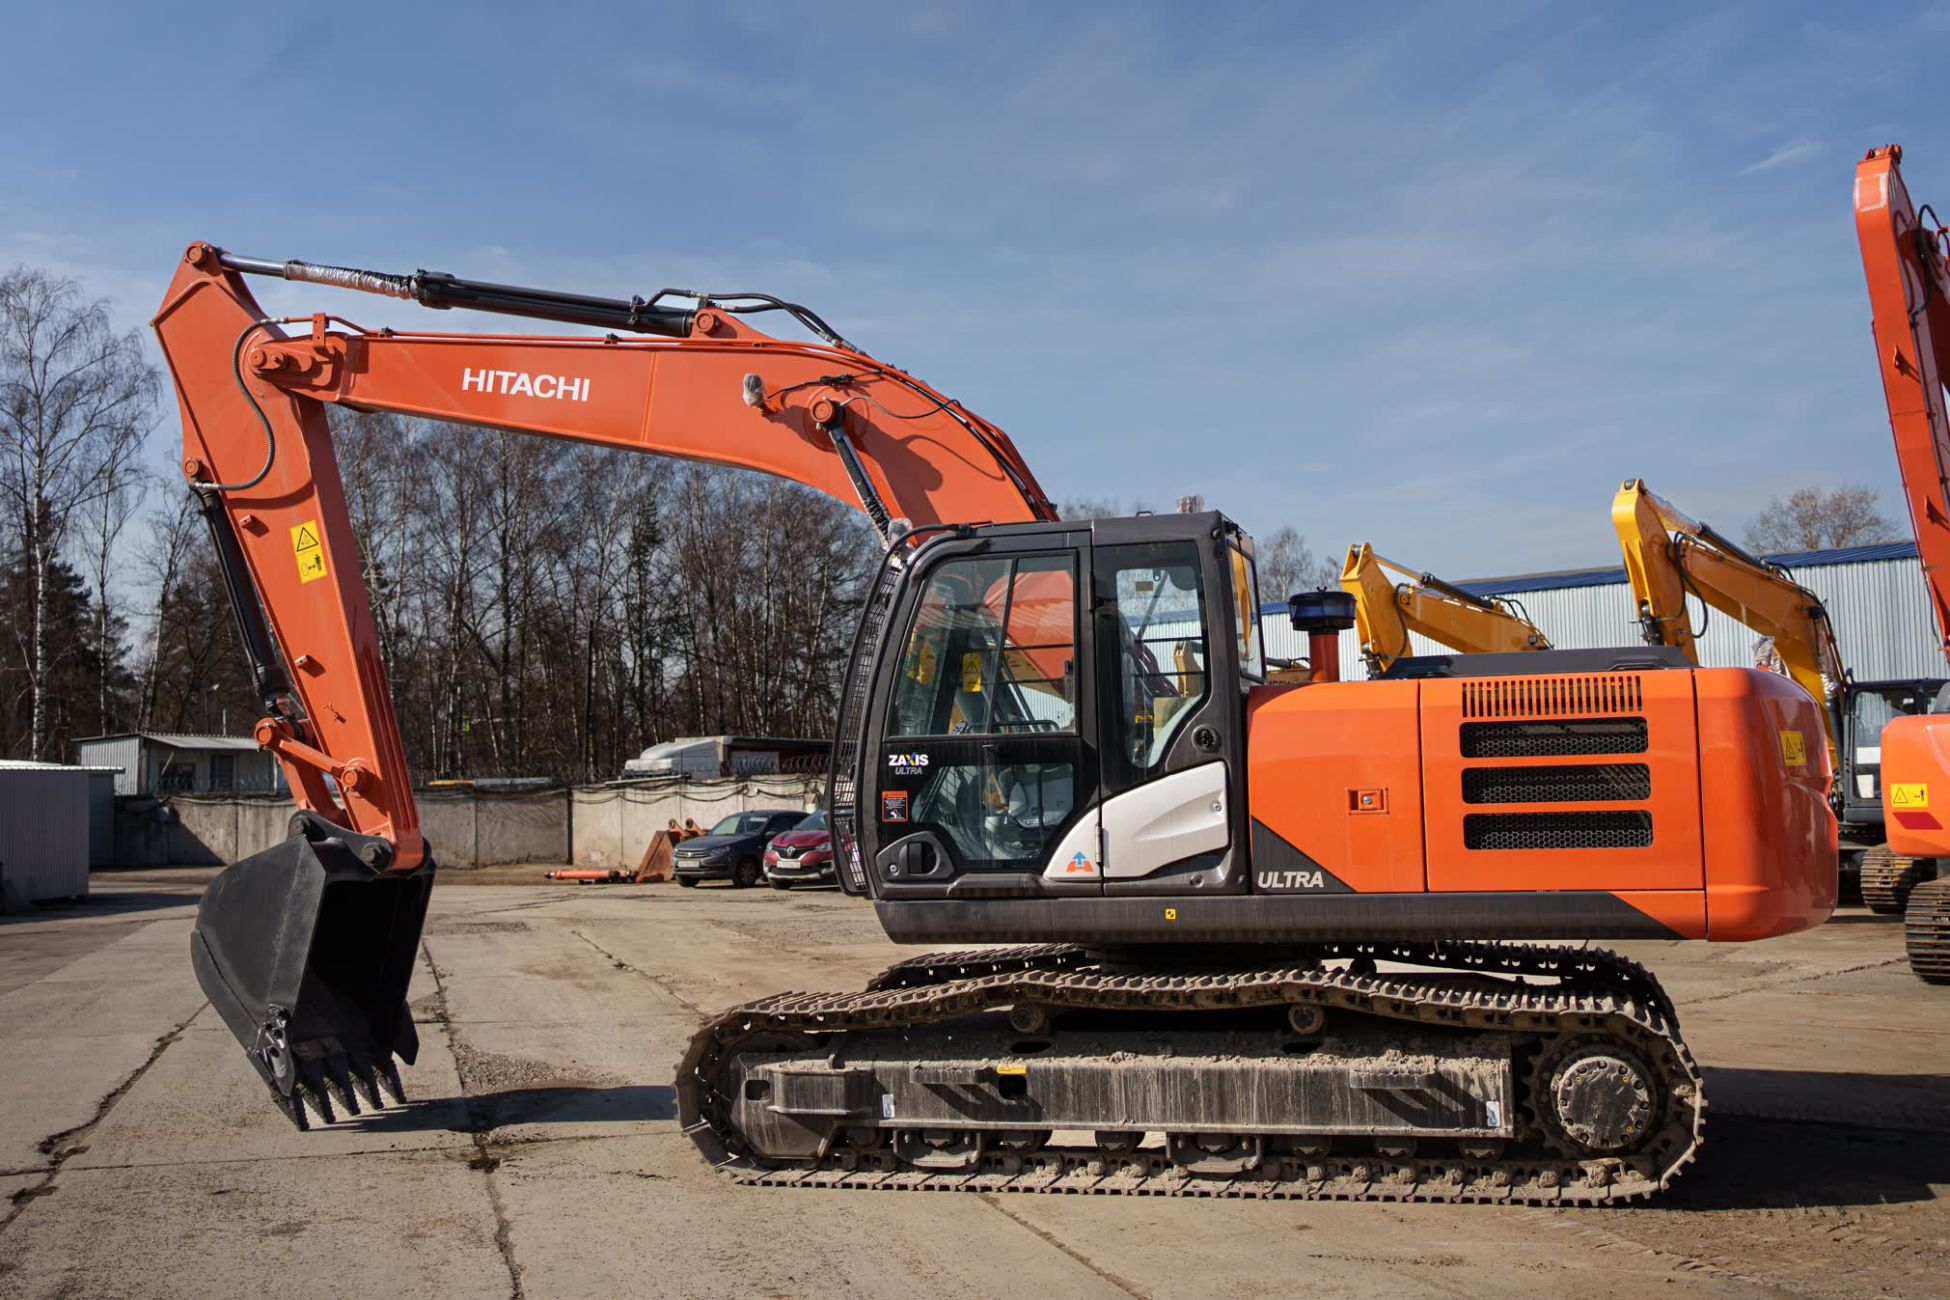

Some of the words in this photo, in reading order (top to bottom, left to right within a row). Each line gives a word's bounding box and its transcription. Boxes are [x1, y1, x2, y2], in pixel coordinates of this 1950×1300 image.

[462, 368, 590, 401] HITACHI
[888, 752, 929, 767] ZAXIS
[895, 767, 923, 775] ULTRA
[1257, 871, 1325, 888] ULTRA
